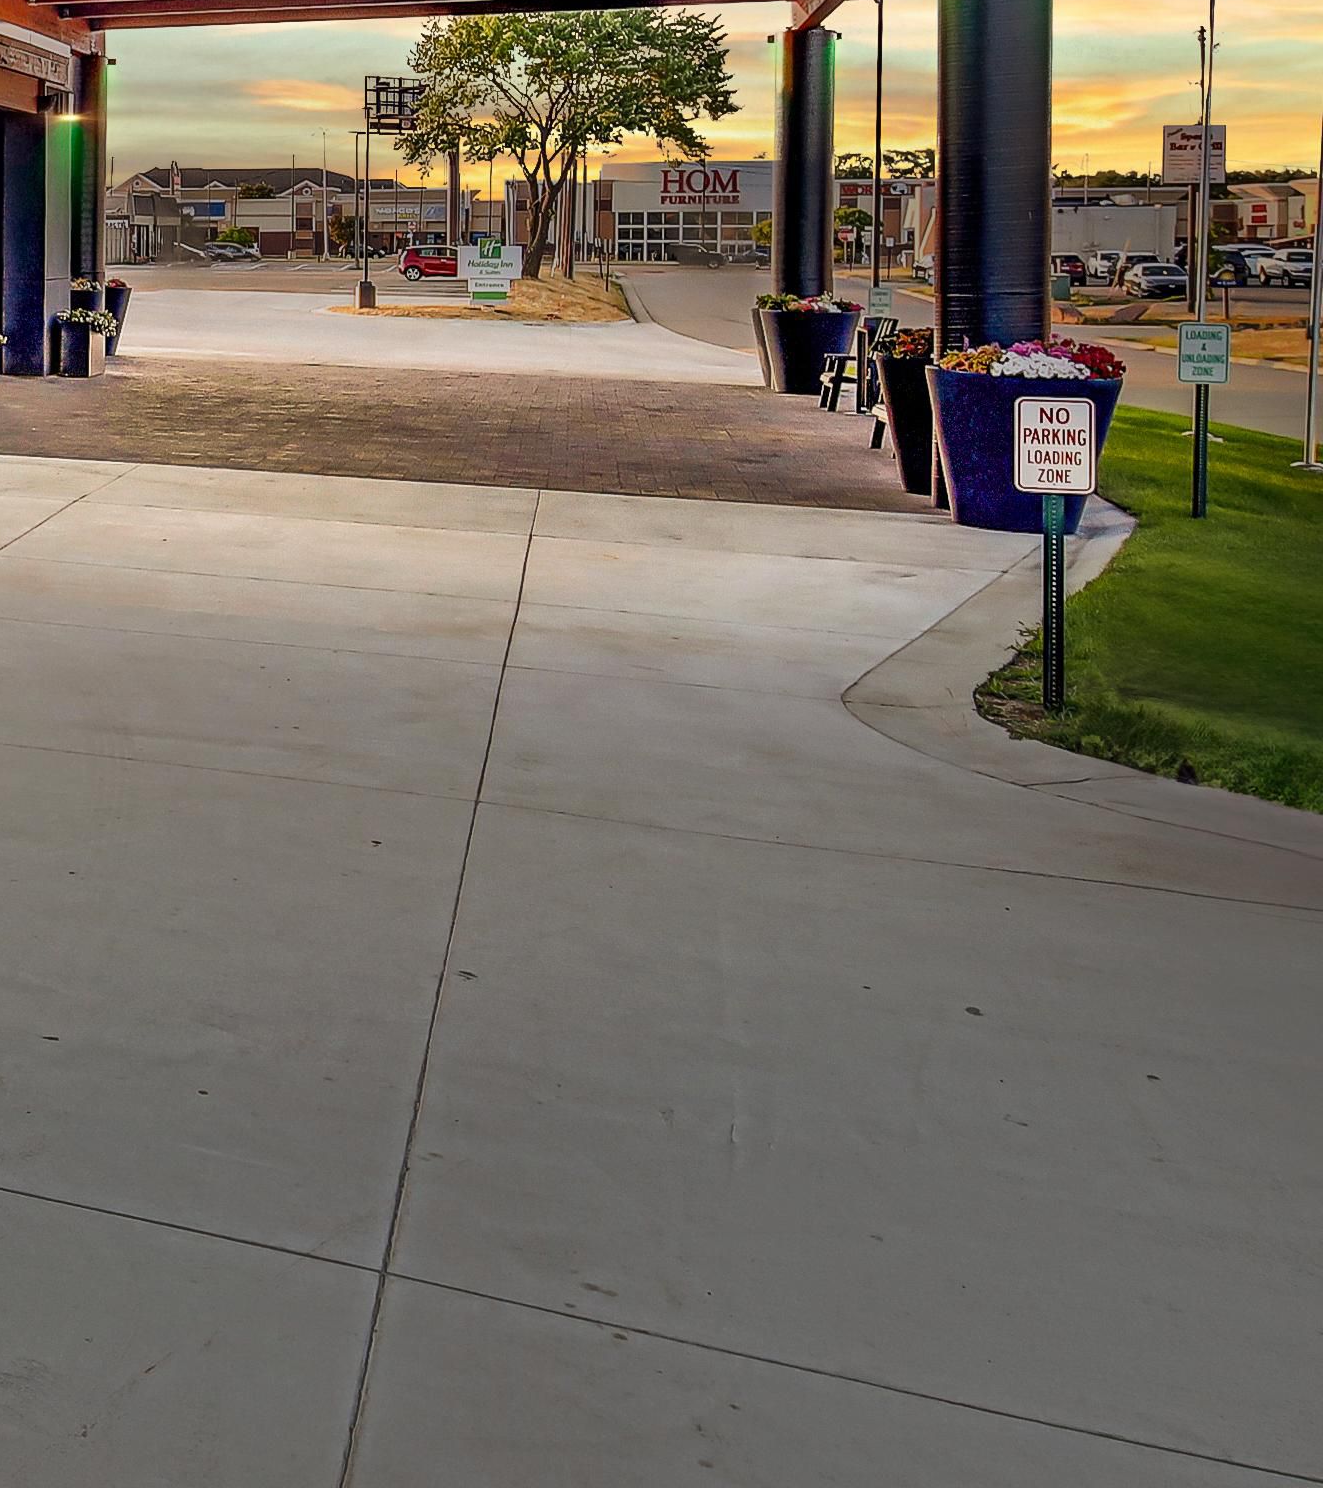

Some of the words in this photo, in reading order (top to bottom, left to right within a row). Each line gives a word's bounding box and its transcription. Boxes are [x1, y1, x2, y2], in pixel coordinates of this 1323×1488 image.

[660, 169, 740, 193] HOM
[660, 195, 740, 204] FURNITURE
[467, 260, 500, 270] Holiday
[501, 260, 513, 268] Inn
[1186, 330, 1222, 341] LOADING
[1201, 343, 1207, 351] &
[1182, 353, 1225, 364] UNLOADING
[1192, 366, 1214, 376] ZONE
[1039, 407, 1070, 425] NO
[1023, 427, 1087, 447] PARKING
[1027, 449, 1082, 466] LOADING
[1037, 468, 1072, 484] ZONE
